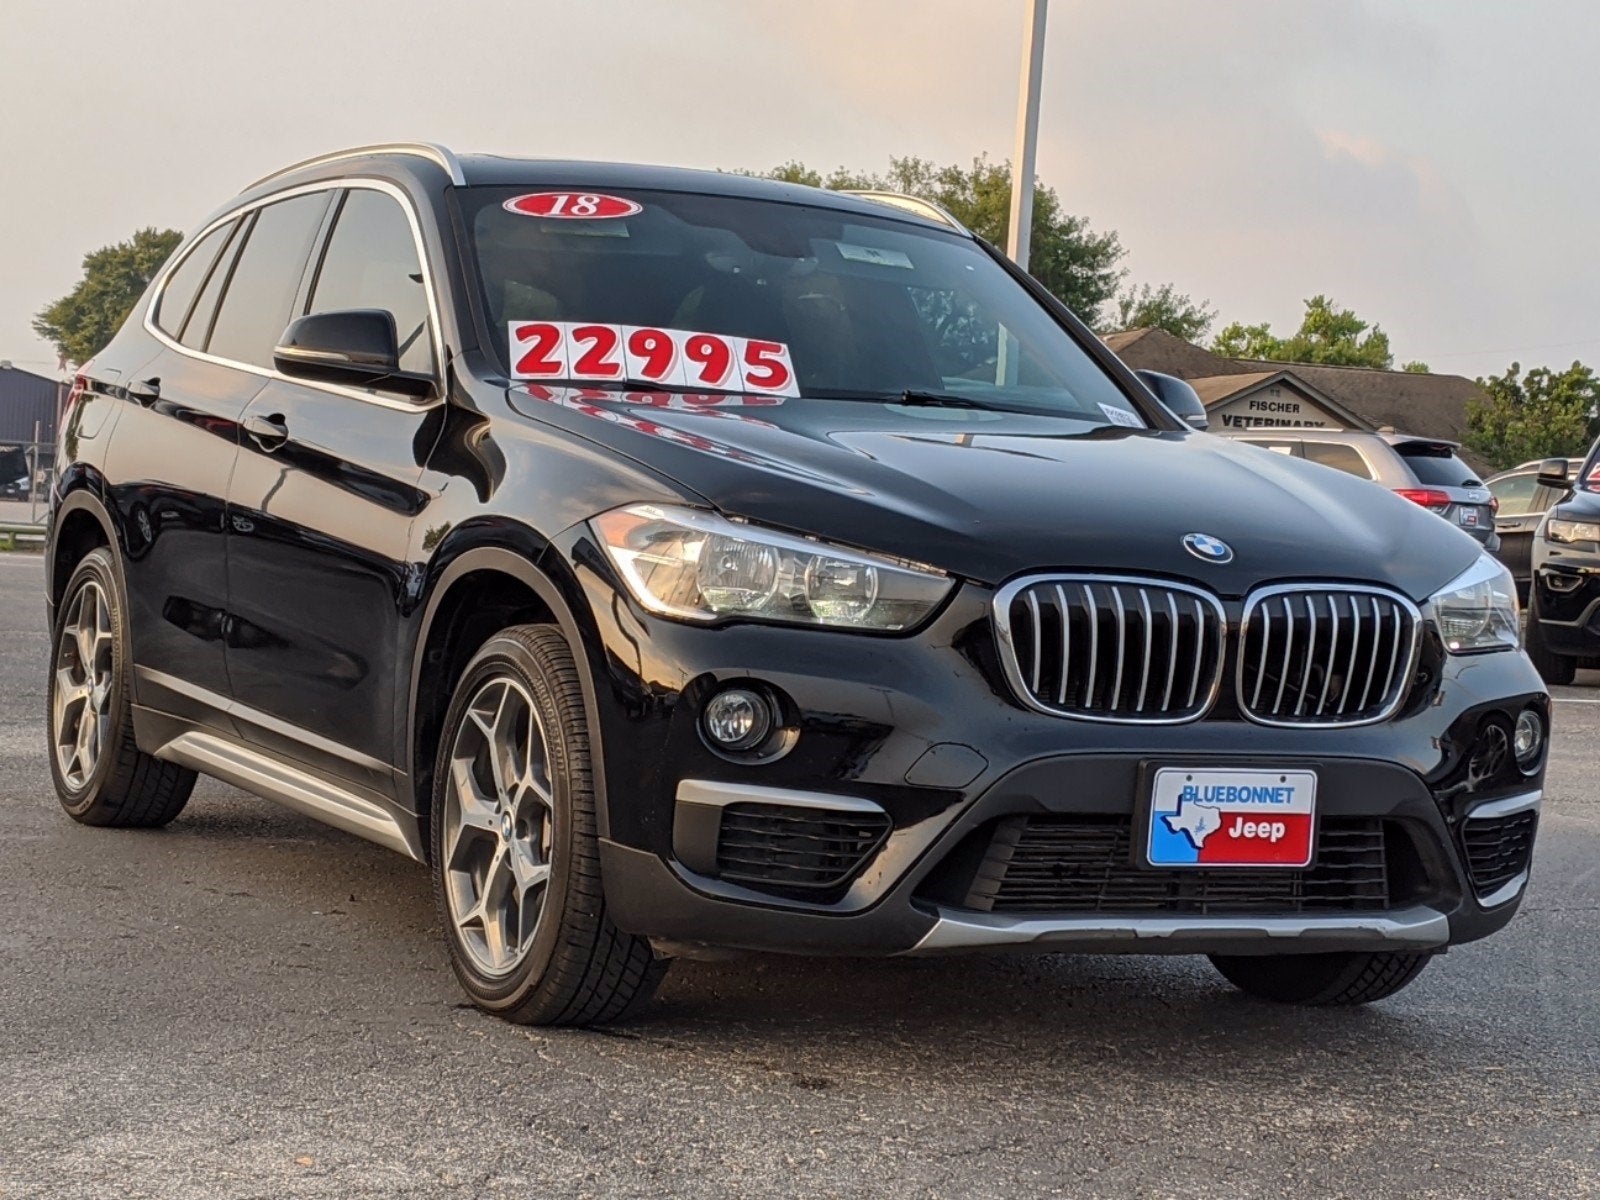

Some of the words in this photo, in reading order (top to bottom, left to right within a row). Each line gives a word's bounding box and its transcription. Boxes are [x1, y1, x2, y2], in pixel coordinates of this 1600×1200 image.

[544, 194, 601, 216] 18
[515, 323, 790, 389] 22995
[1249, 401, 1300, 413] FISCHER
[1182, 785, 1295, 804] BLUEBONNET
[1228, 816, 1285, 842] Jeep
